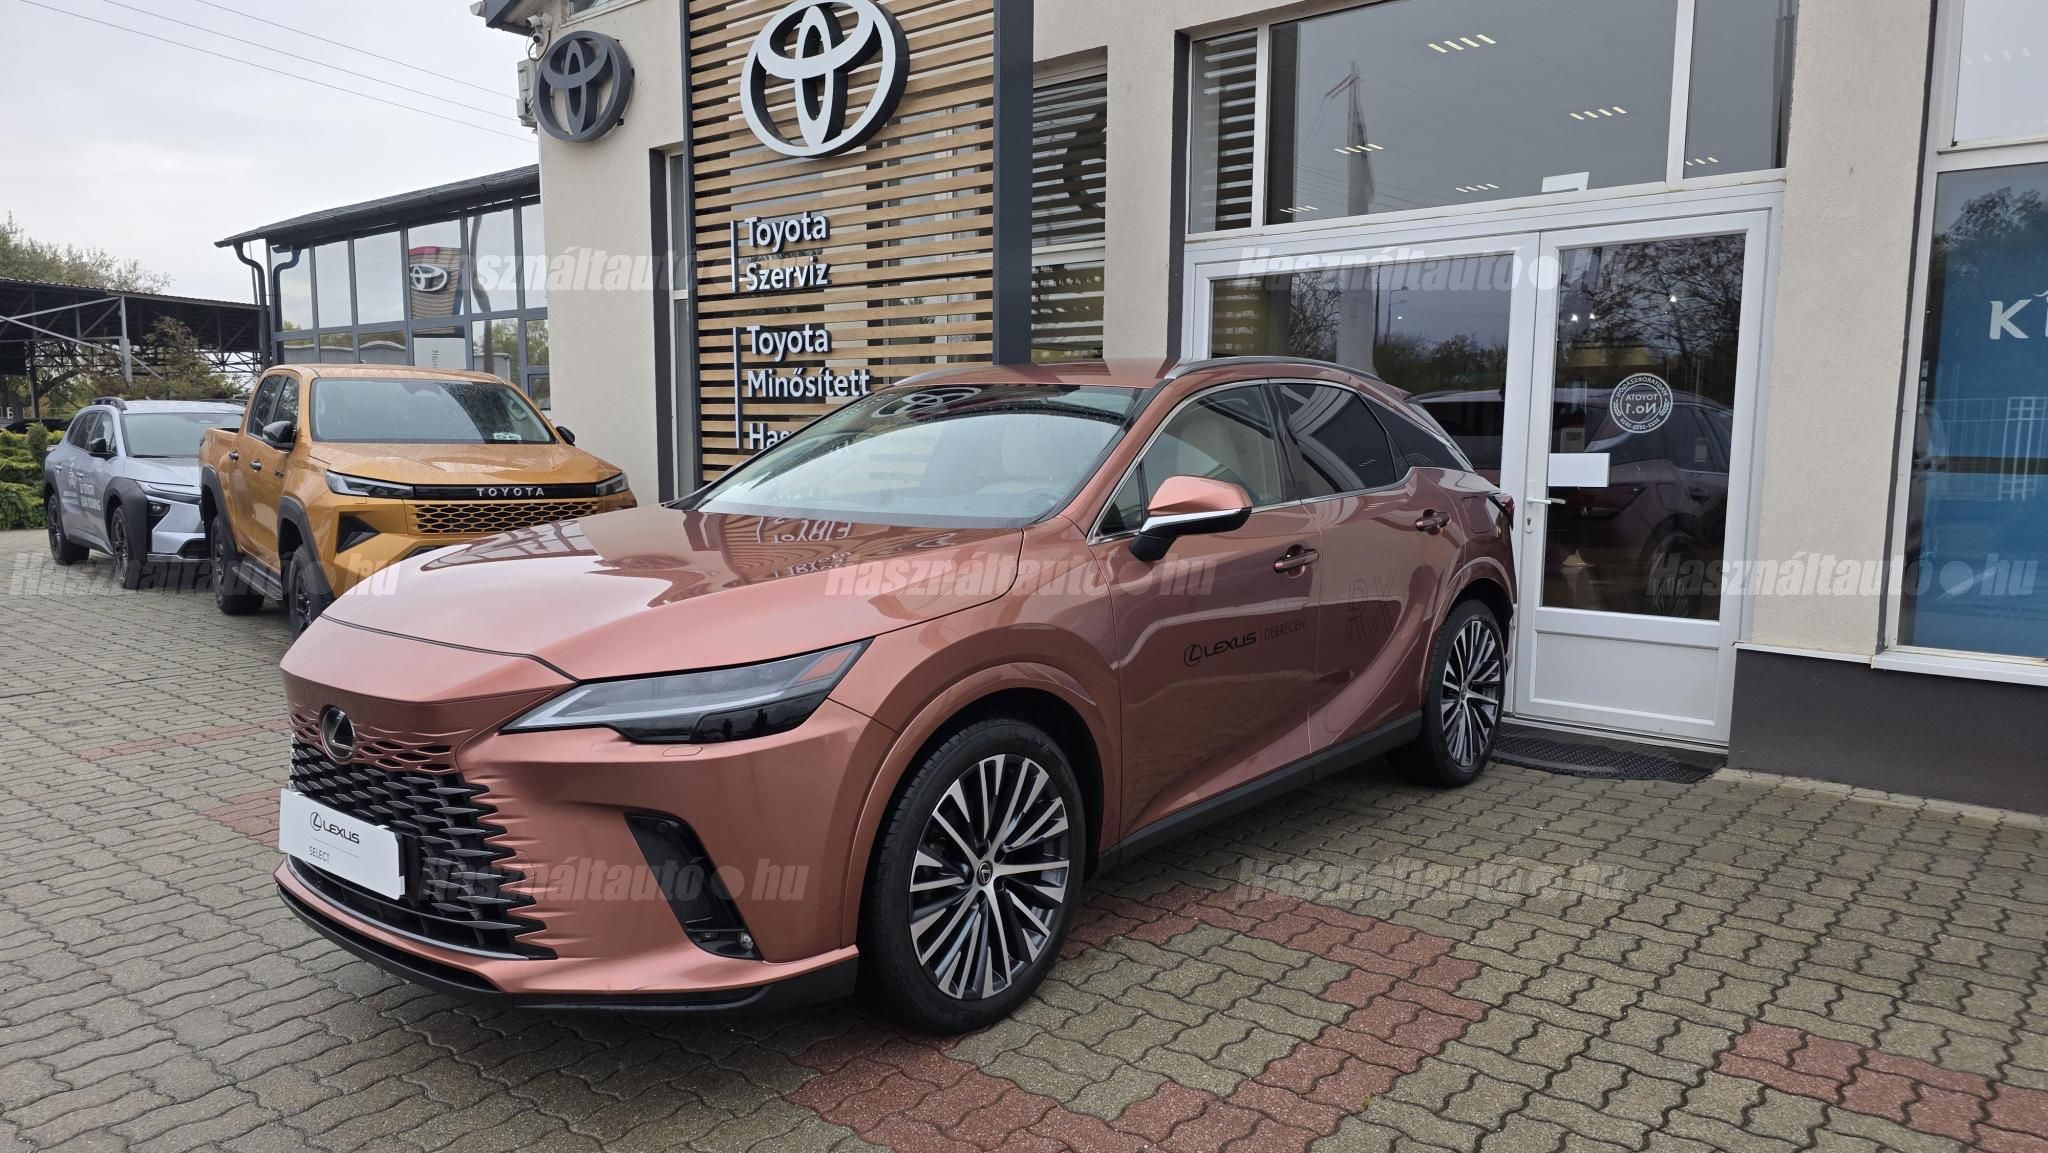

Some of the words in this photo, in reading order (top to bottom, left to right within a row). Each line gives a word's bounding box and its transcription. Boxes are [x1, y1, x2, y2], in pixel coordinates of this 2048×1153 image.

[744, 211, 829, 252] Toyota
[745, 255, 831, 291] Szerviz
[746, 324, 829, 363] Toyota
[747, 367, 871, 398] Minősített
[476, 487, 545, 497] TOYOTA
[1203, 631, 1257, 657] LEXUS
[1264, 618, 1306, 642] DEBRECEN
[322, 820, 361, 844] LEXUS
[309, 846, 330, 863] SELECT
